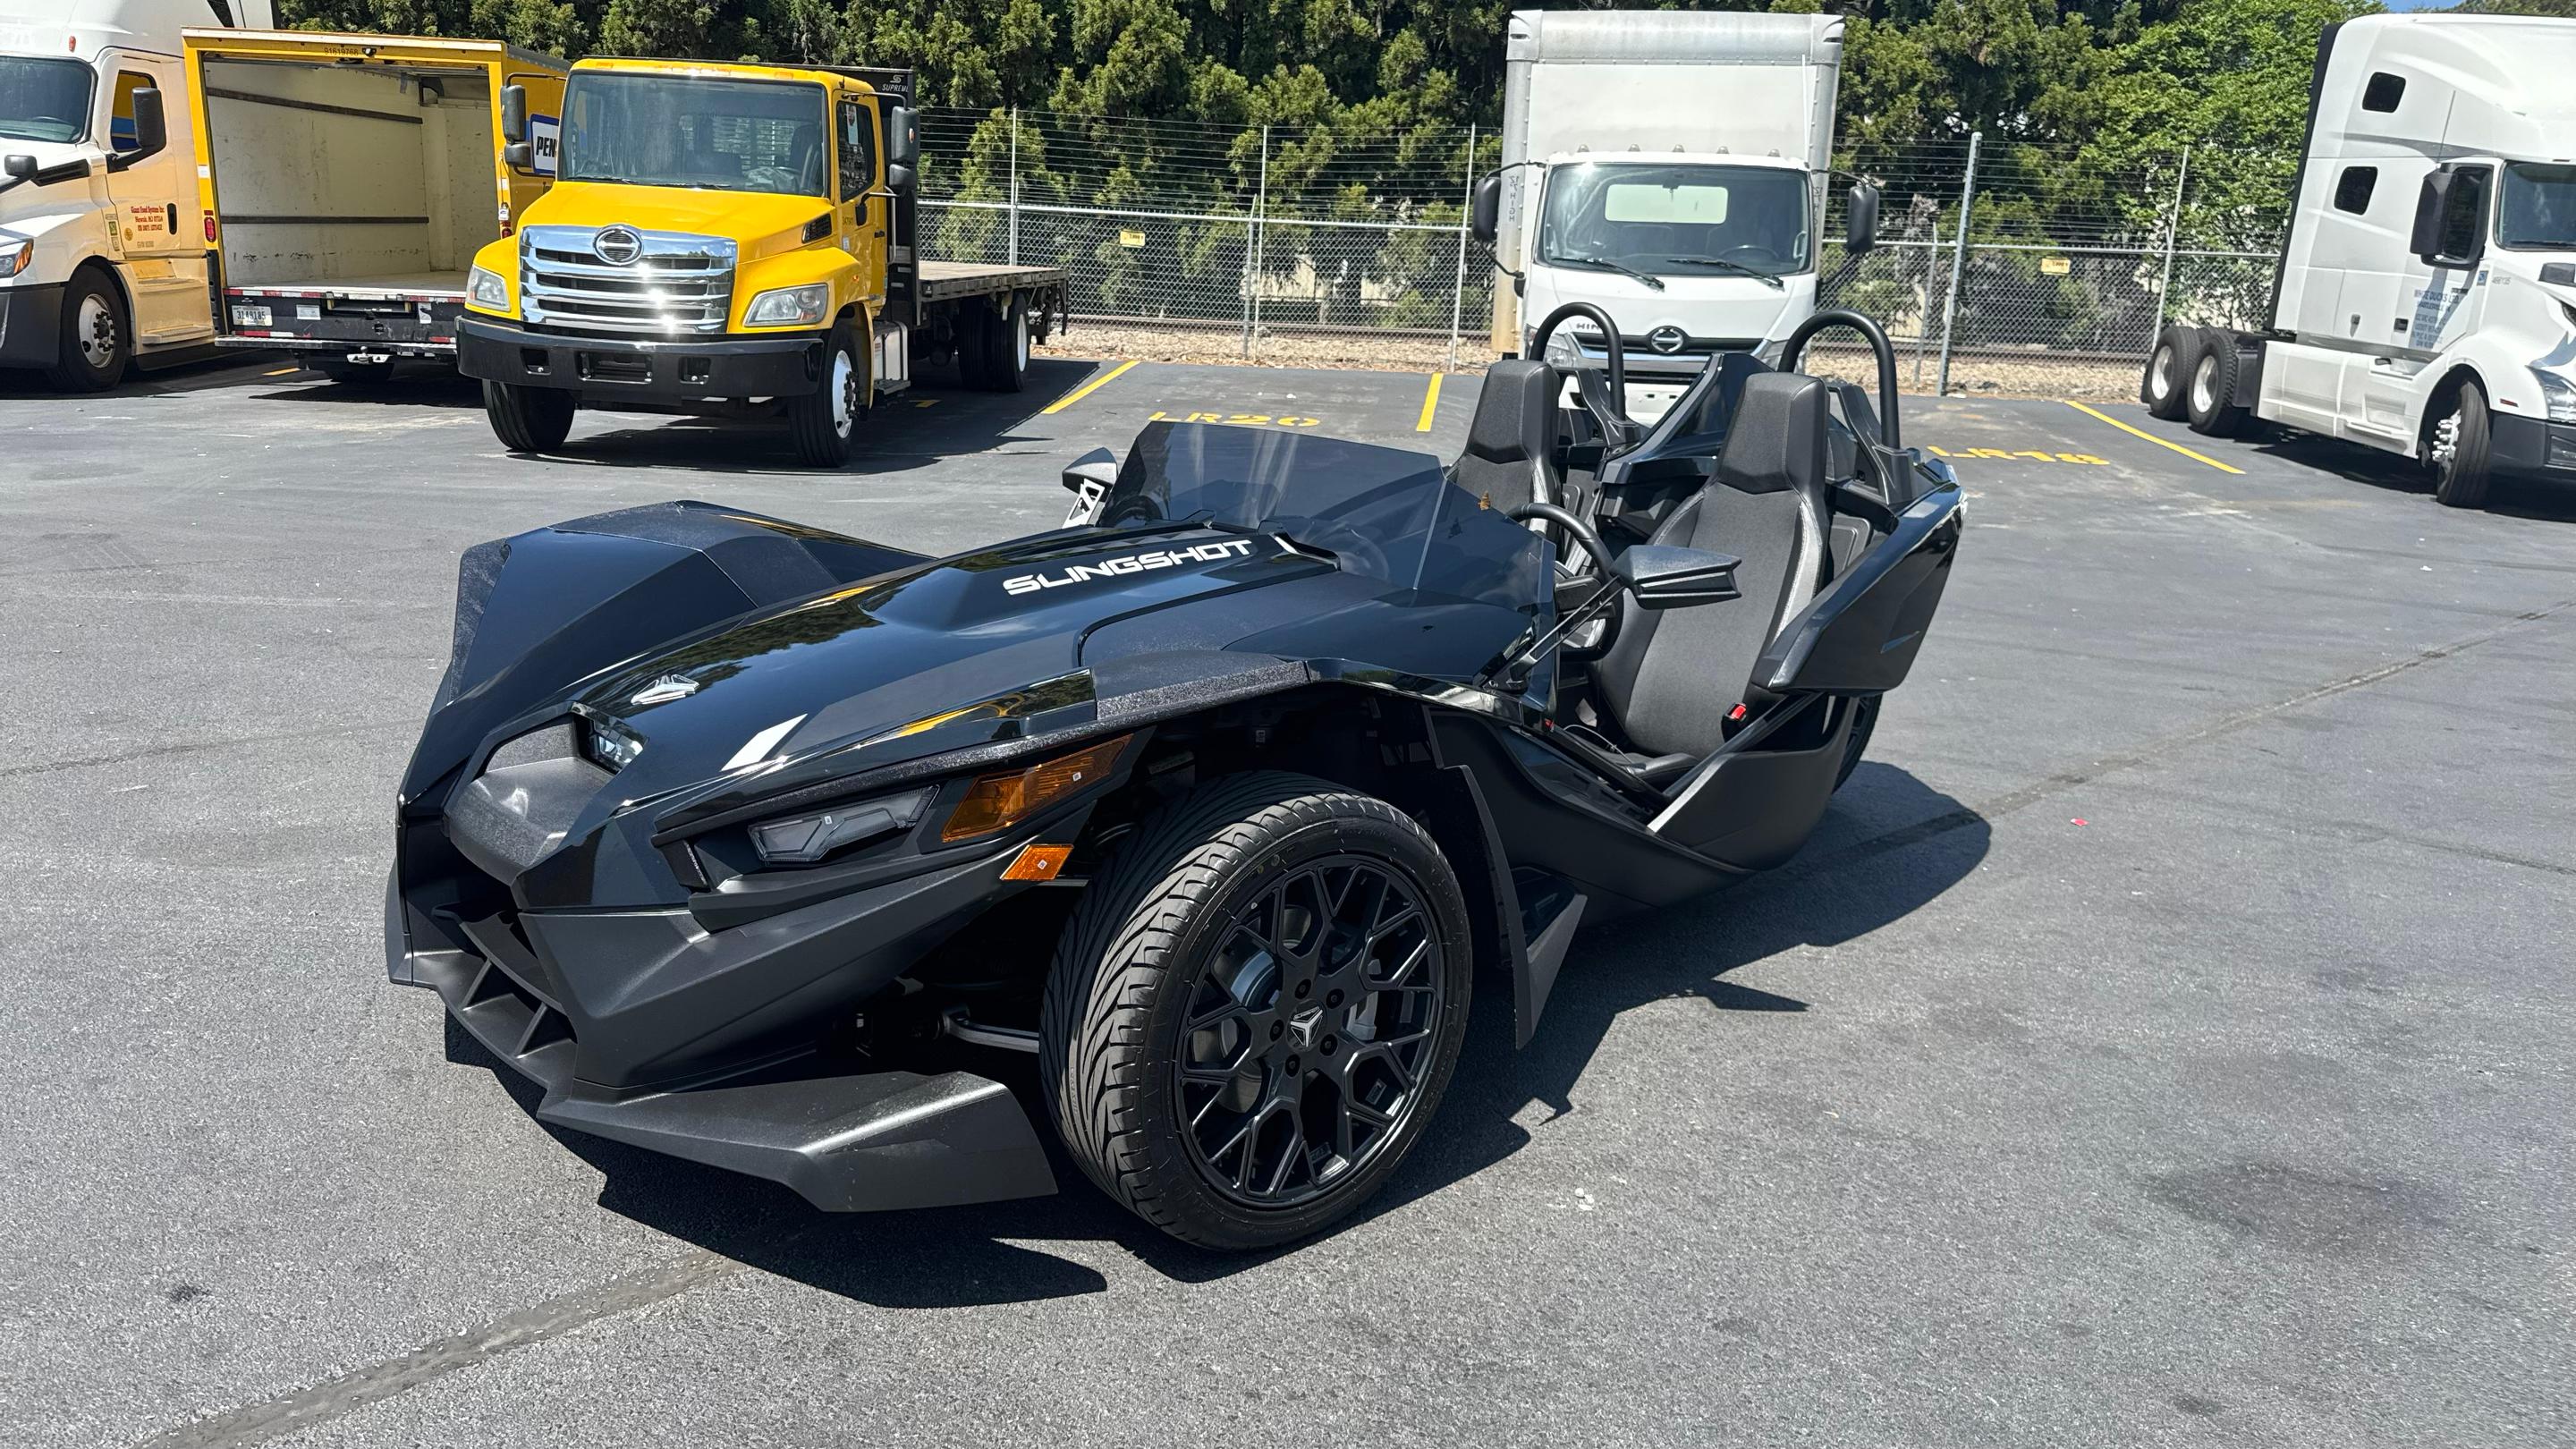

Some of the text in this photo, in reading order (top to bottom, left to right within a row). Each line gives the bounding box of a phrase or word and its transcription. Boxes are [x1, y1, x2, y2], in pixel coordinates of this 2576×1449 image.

[536, 135, 557, 157] PEN
[1148, 411, 1321, 427] LR20
[1003, 539, 1252, 596] SLINGSHOT
